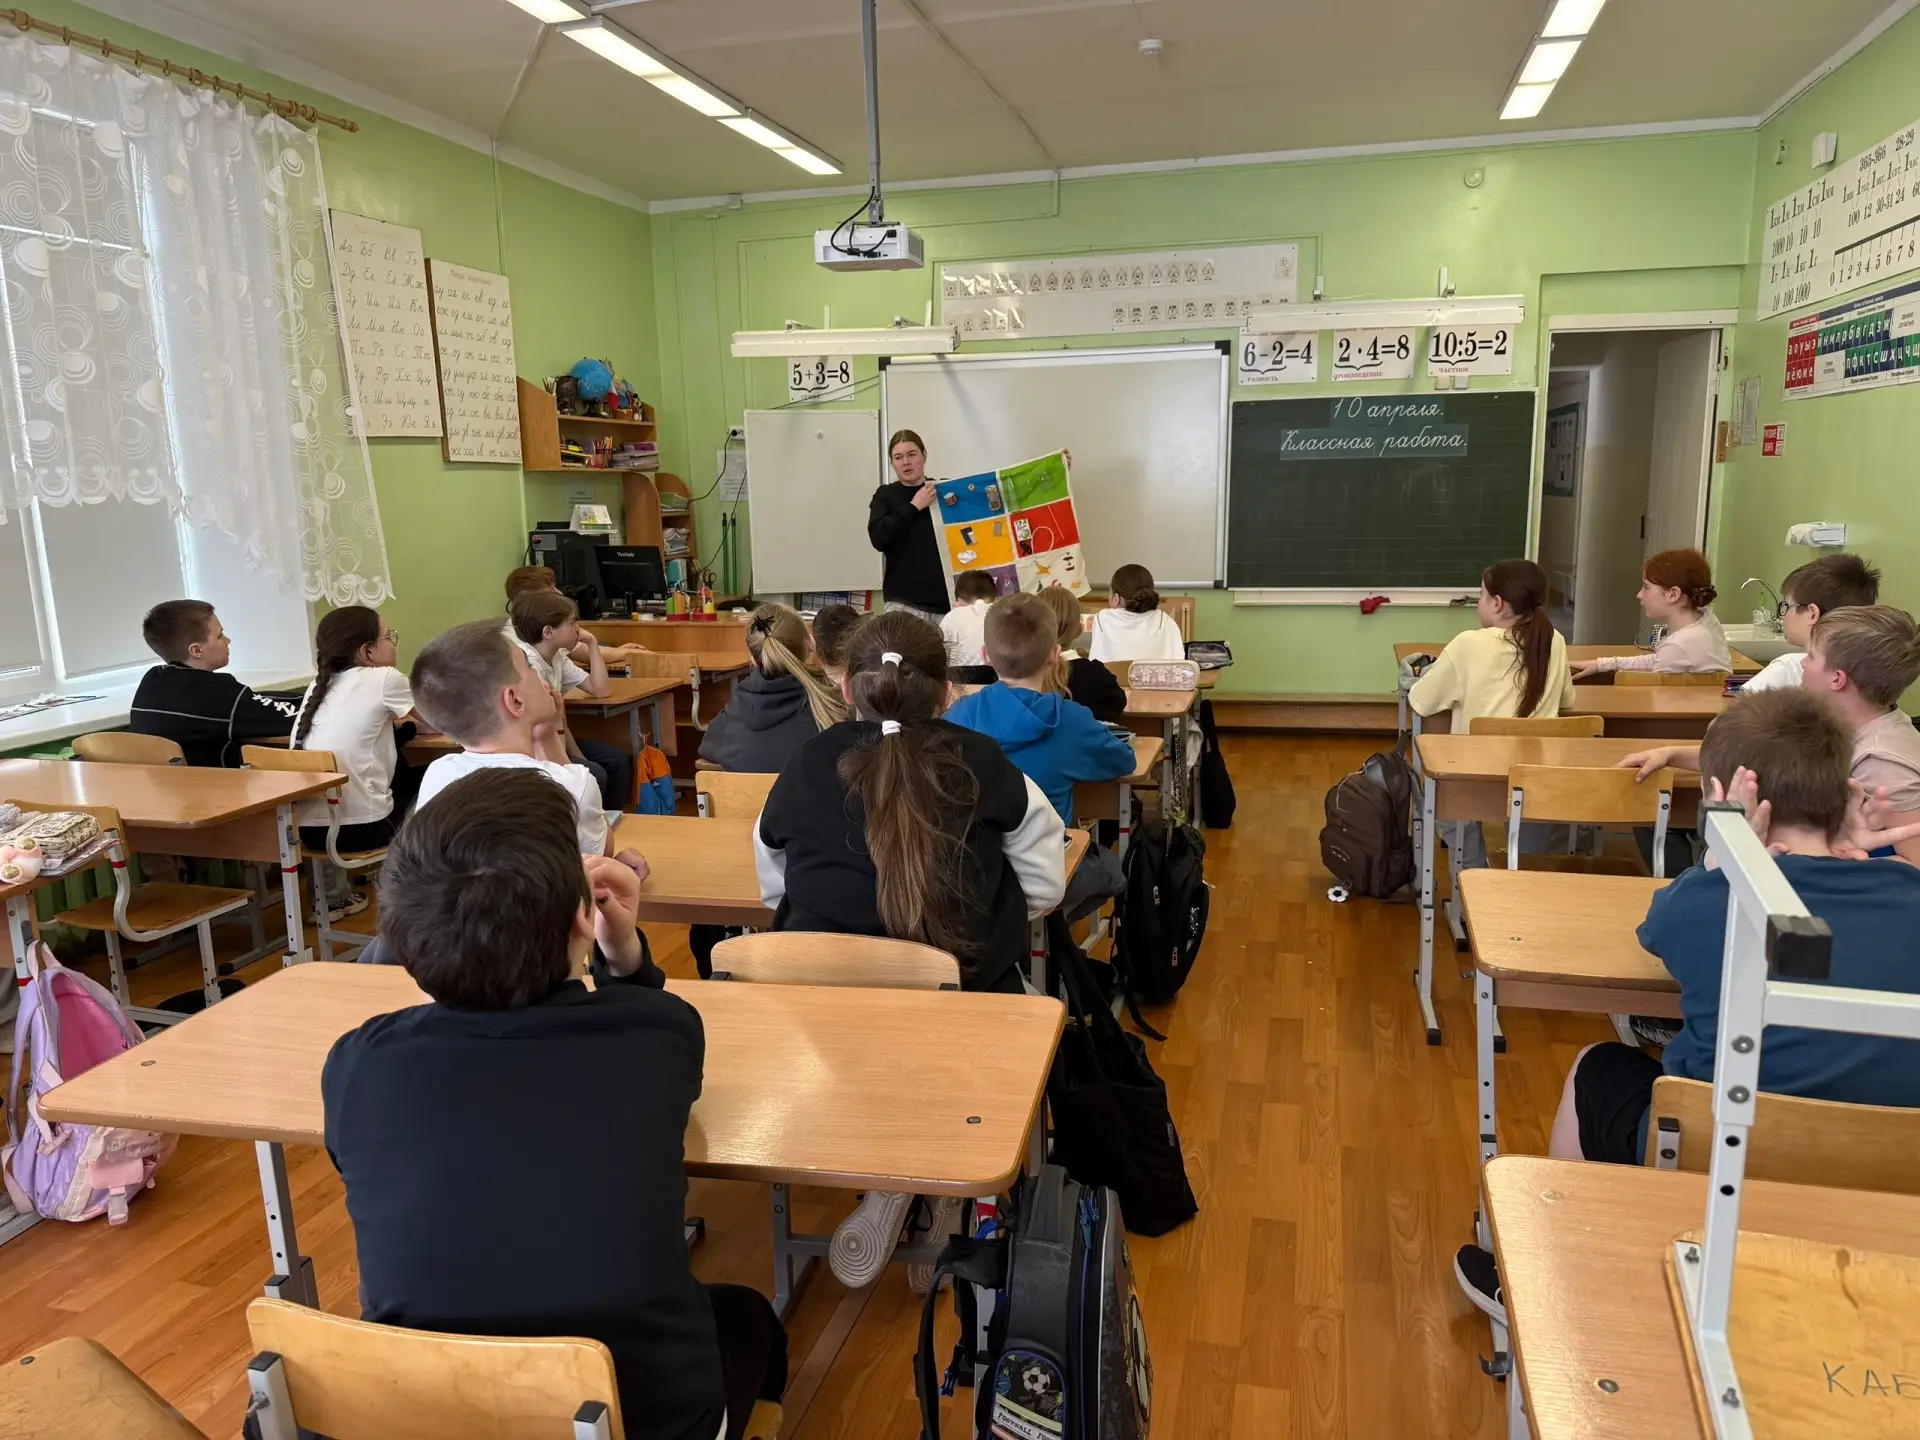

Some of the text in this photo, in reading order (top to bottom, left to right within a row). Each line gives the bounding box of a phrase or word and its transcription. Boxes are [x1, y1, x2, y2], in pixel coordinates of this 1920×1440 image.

[1864, 202, 1872, 220] 12
[1895, 186, 1905, 204] 24
[1799, 225, 1808, 245] 10
[1813, 218, 1821, 238] 10
[1830, 240, 1914, 286] 0 1 2 3 4 5 6 7 8
[1431, 330, 1507, 357] 10:5=2
[1849, 325, 1854, 340] б
[1852, 353, 1858, 371] ф
[1874, 352, 1878, 363] с
[1881, 350, 1888, 362] ш
[1890, 349, 1895, 360] х
[1906, 345, 1910, 357] ч
[1334, 397, 1443, 425] 10 апреля.
[1281, 426, 1467, 457] Классная работа.
[998, 1412, 1031, 1435] FOOTBALL
